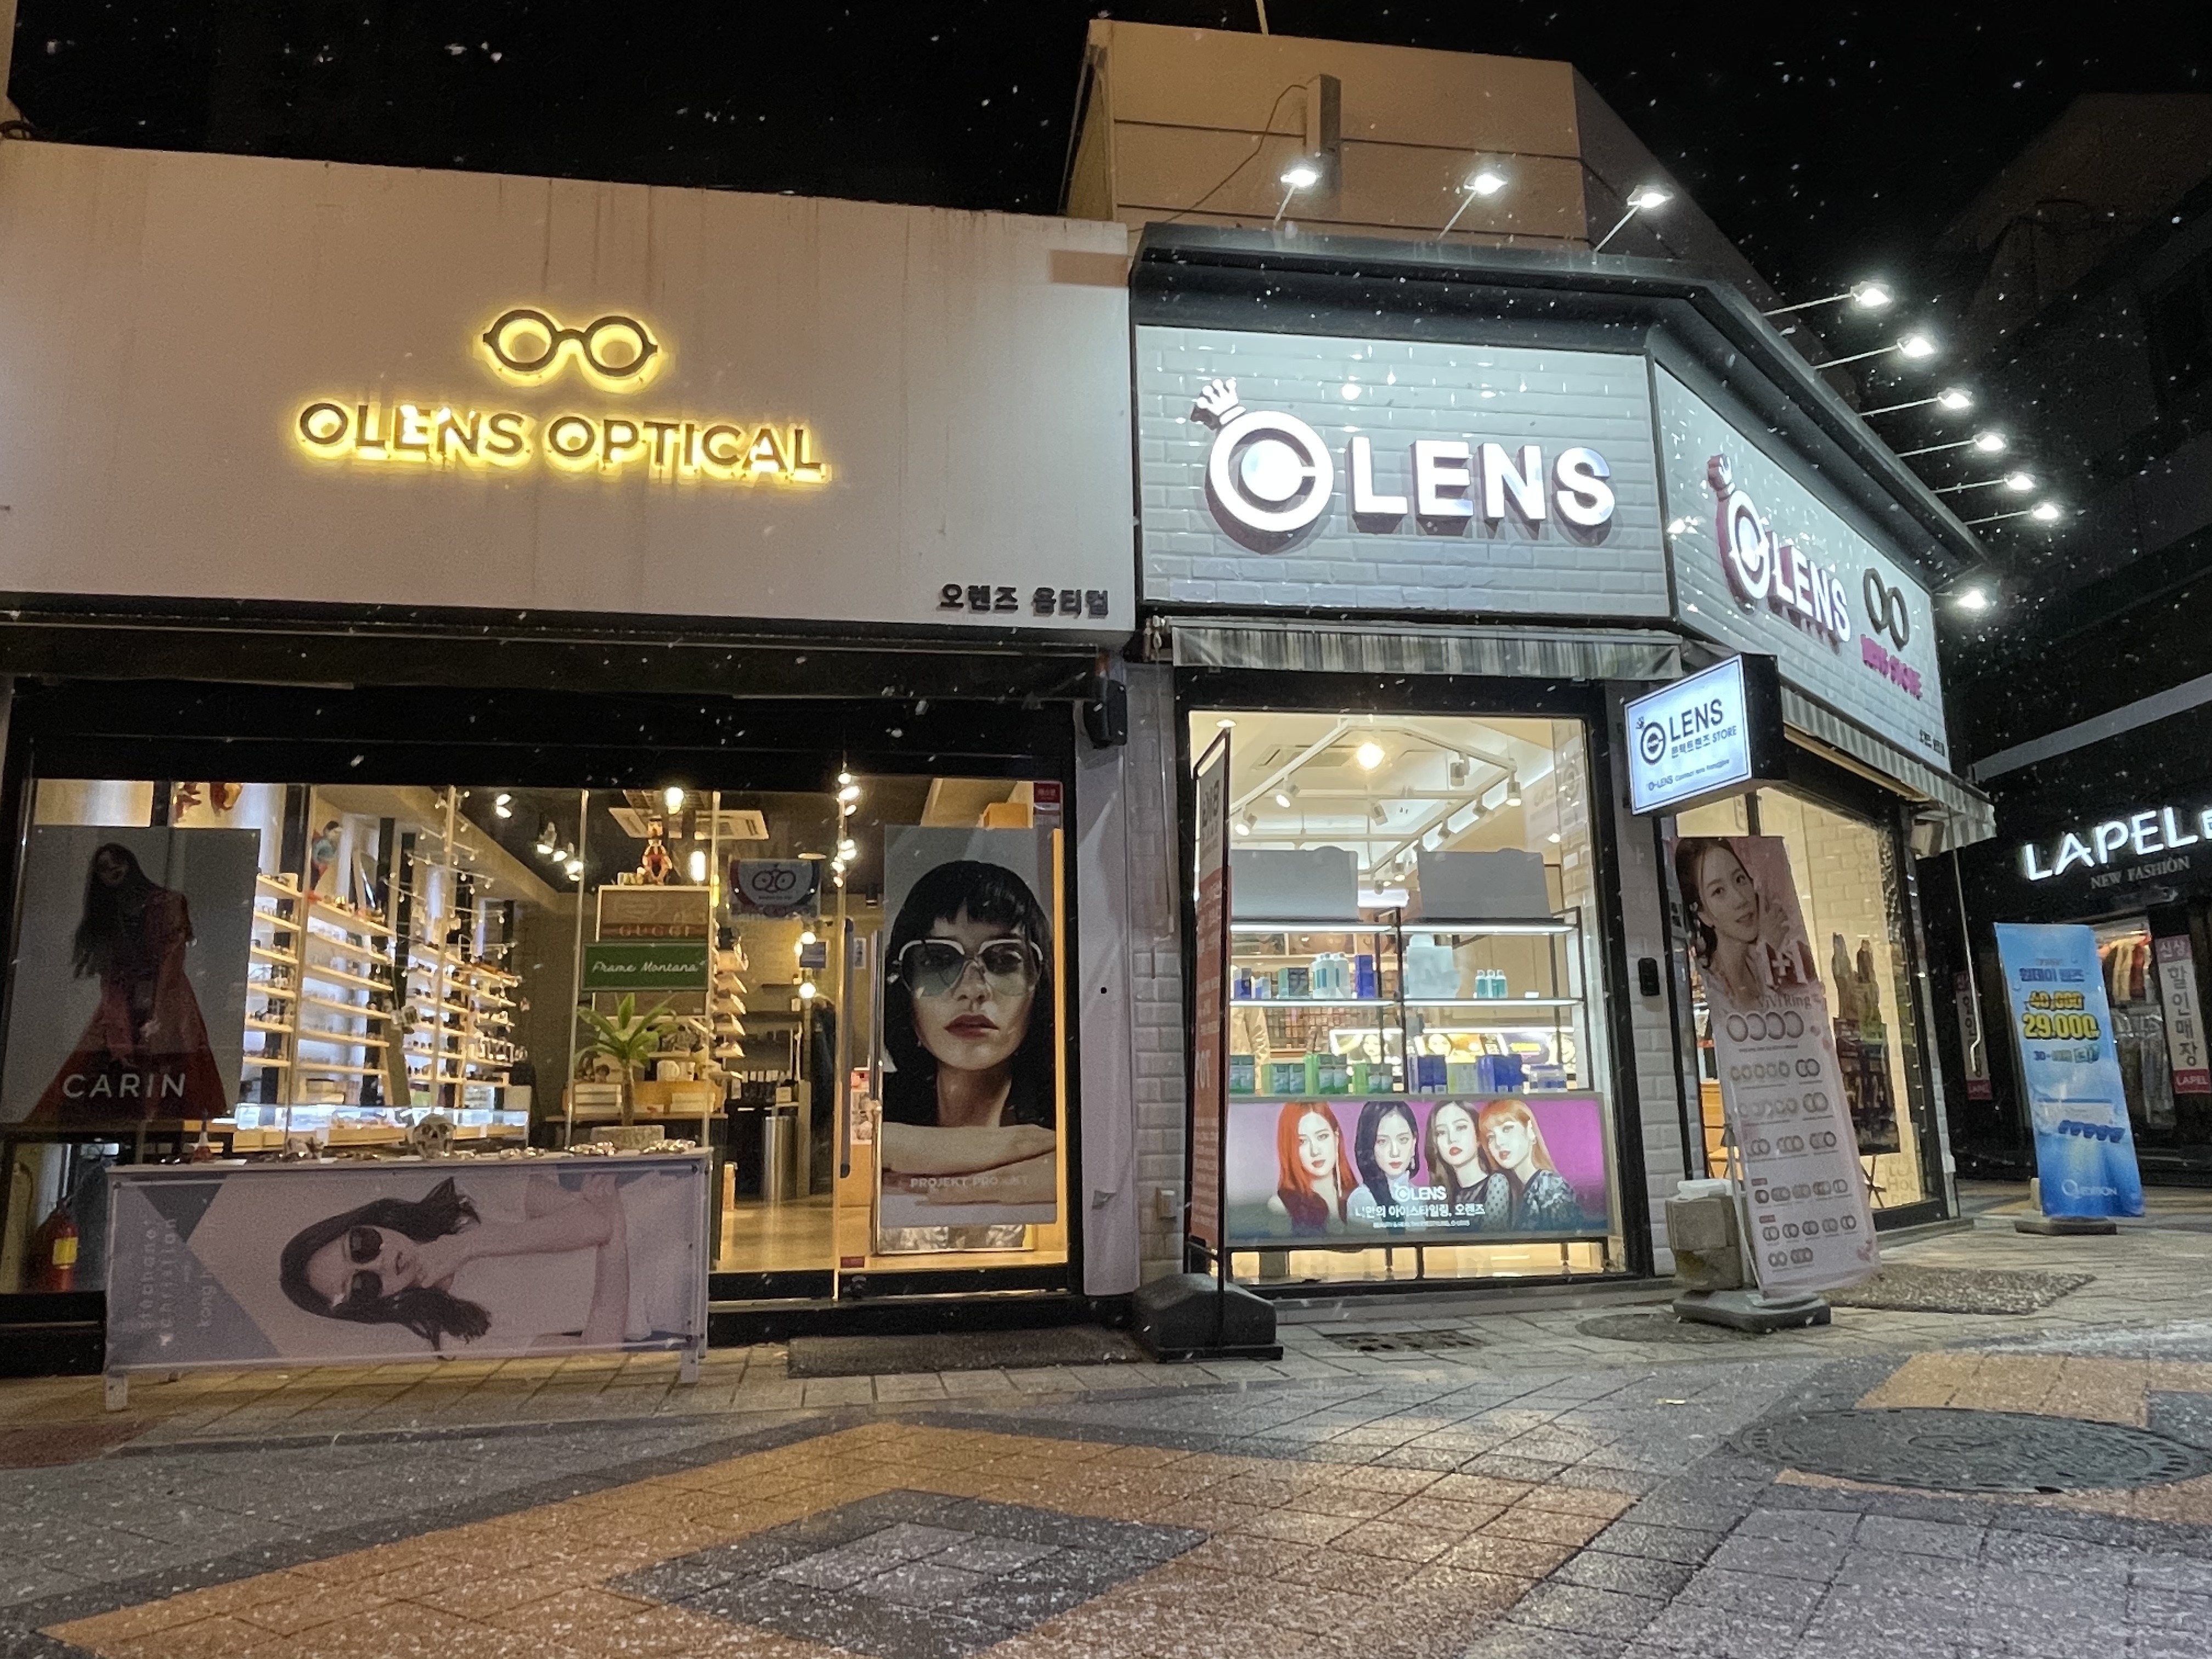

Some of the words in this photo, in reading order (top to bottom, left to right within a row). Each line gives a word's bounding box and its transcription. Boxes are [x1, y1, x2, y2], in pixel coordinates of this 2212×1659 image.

[299, 402, 527, 458] OLENS
[548, 415, 825, 473] OPTICAL
[940, 584, 1019, 611] 오렌즈
[1712, 725, 1737, 743] STORE
[2091, 870, 2122, 889] NEW
[2126, 855, 2191, 882] FASHION
[2167, 965, 2198, 1066] 할인매장
[62, 1073, 186, 1098] CARIN
